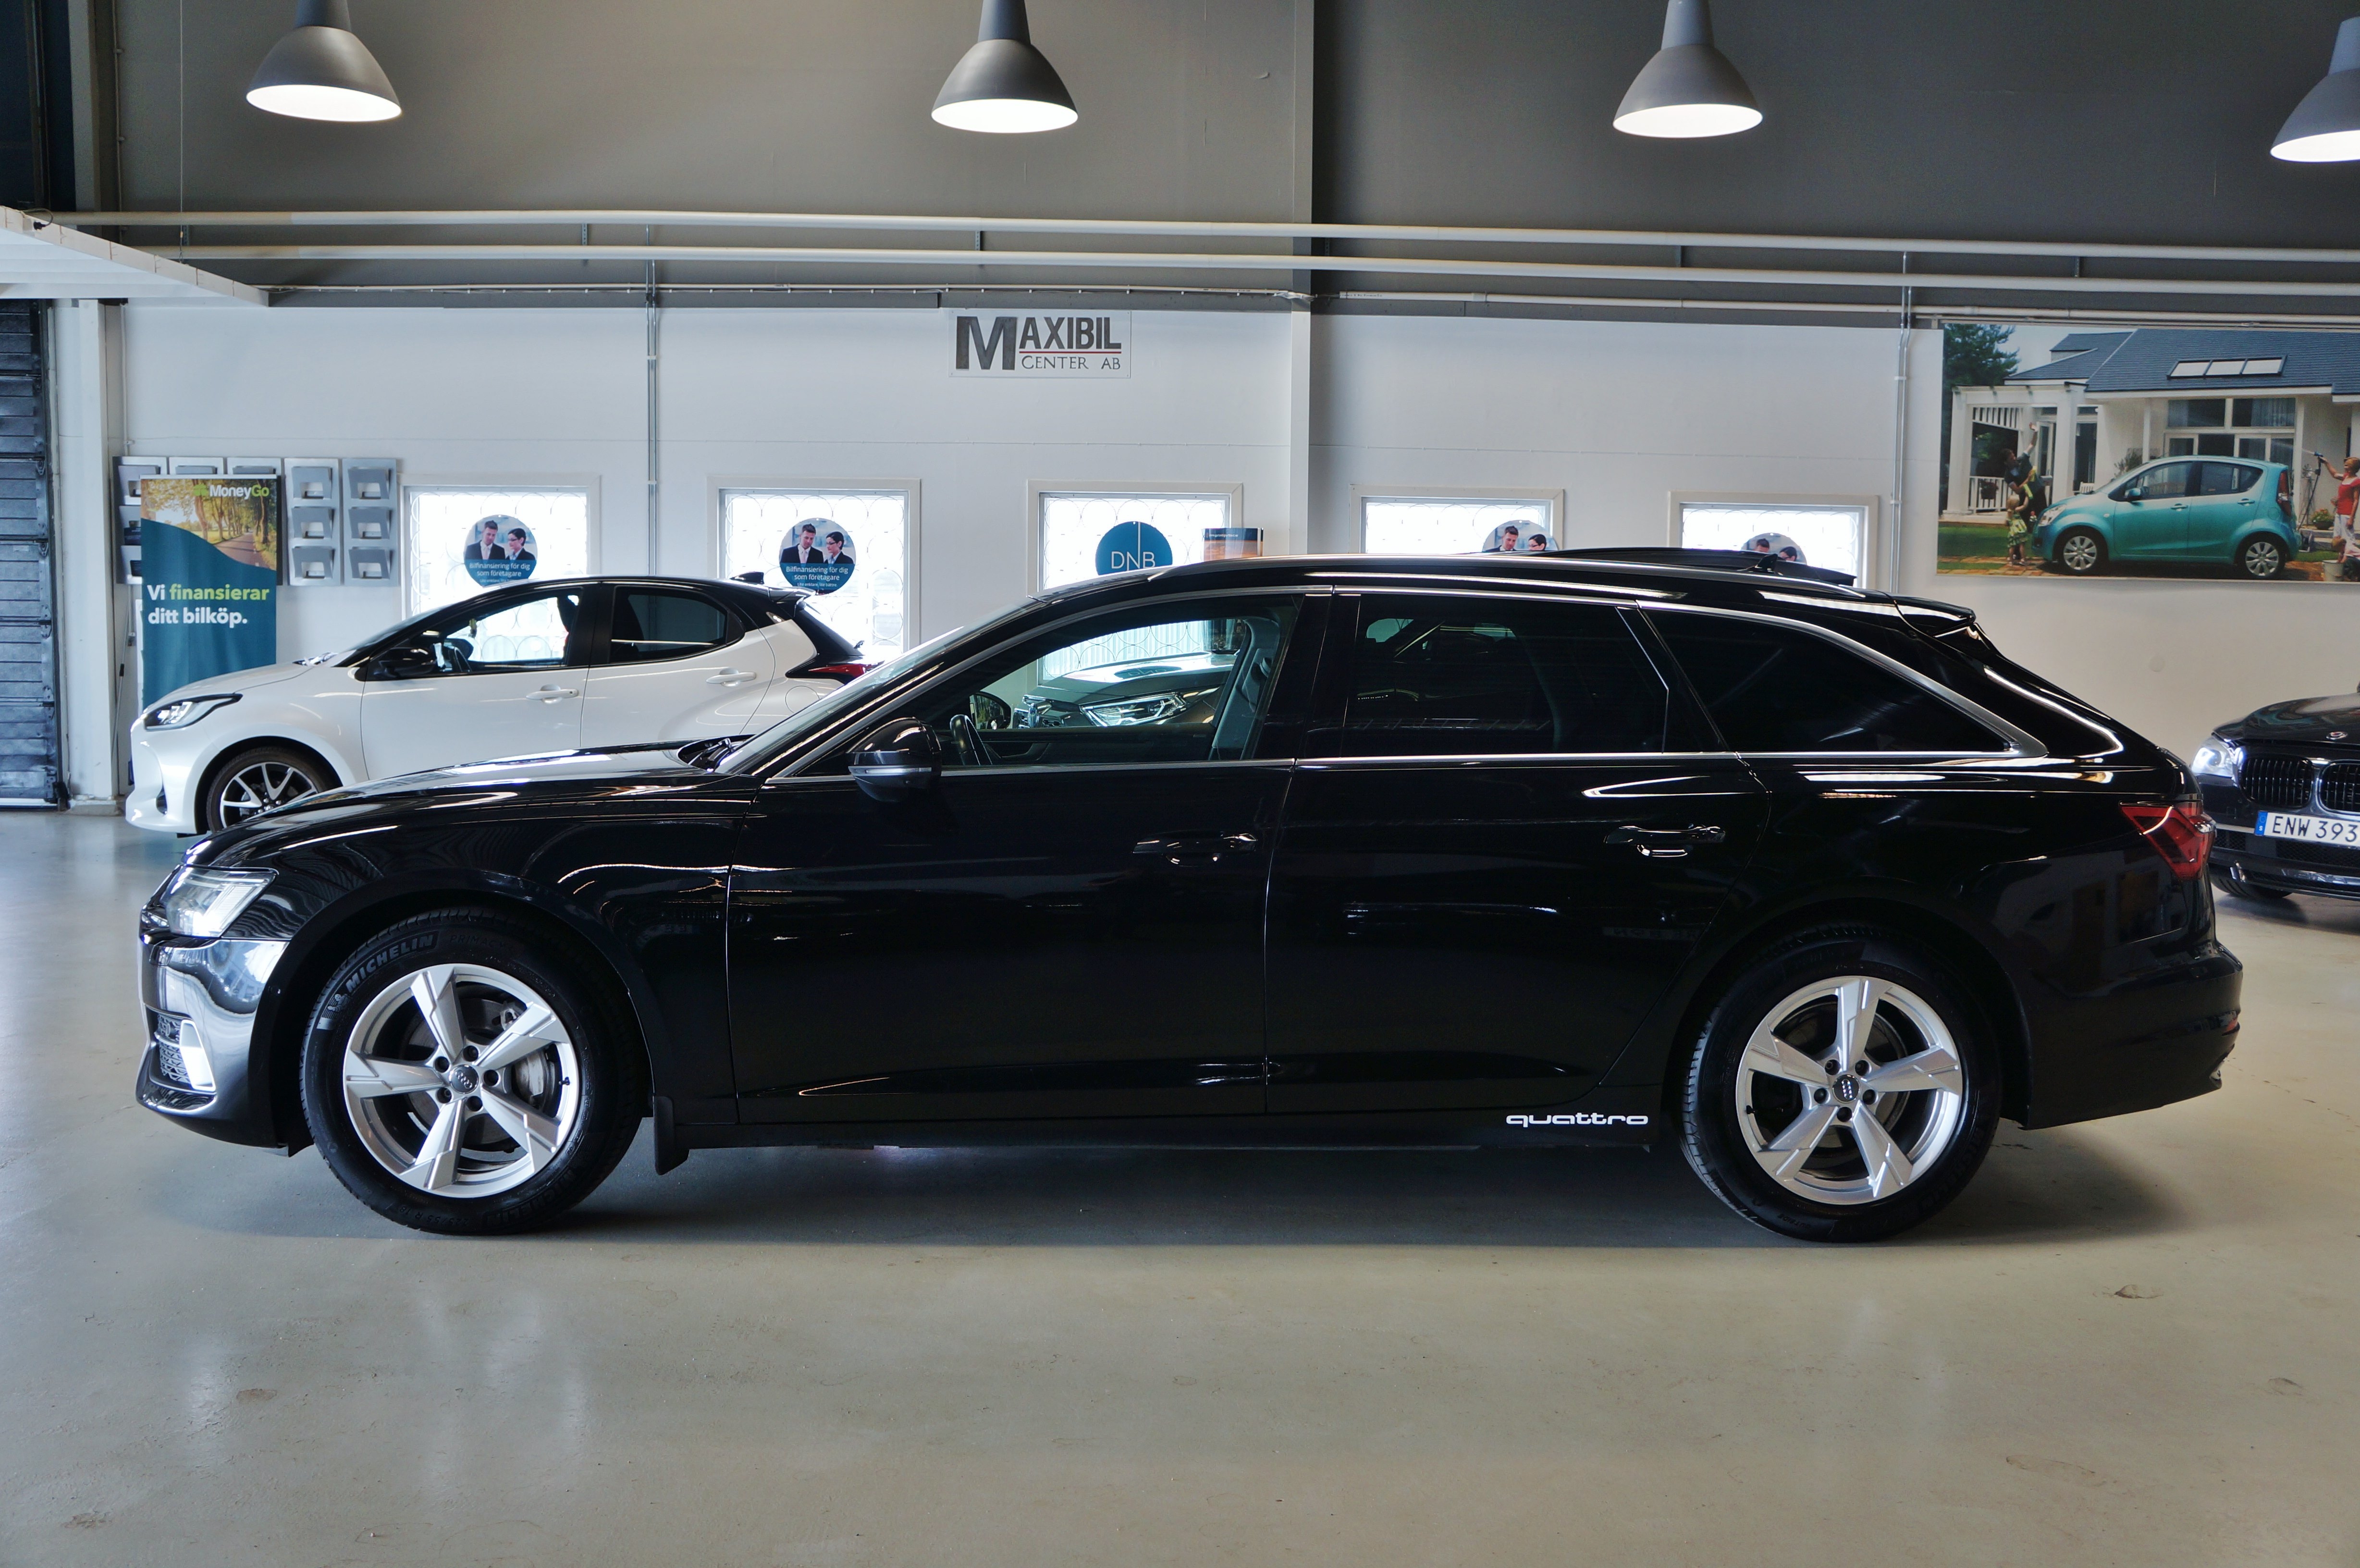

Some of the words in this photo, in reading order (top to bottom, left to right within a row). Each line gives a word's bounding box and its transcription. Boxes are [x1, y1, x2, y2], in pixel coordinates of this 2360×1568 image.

[956, 316, 1122, 370] MAXIBIL
[1021, 355, 1089, 369] CENTER
[1101, 357, 1121, 369] AB
[209, 484, 270, 500] MoneyGo
[786, 566, 828, 574] Bilfinansiering
[1111, 551, 1155, 571] DNB
[147, 584, 166, 600] Vi
[169, 583, 270, 600] finansierar
[148, 607, 179, 624] ditt
[183, 607, 247, 628] bilköp.
[2272, 815, 2311, 836] ENW
[2315, 820, 2358, 842] 393
[345, 934, 433, 993] MICHELIN
[1506, 1113, 1648, 1127] quattro
